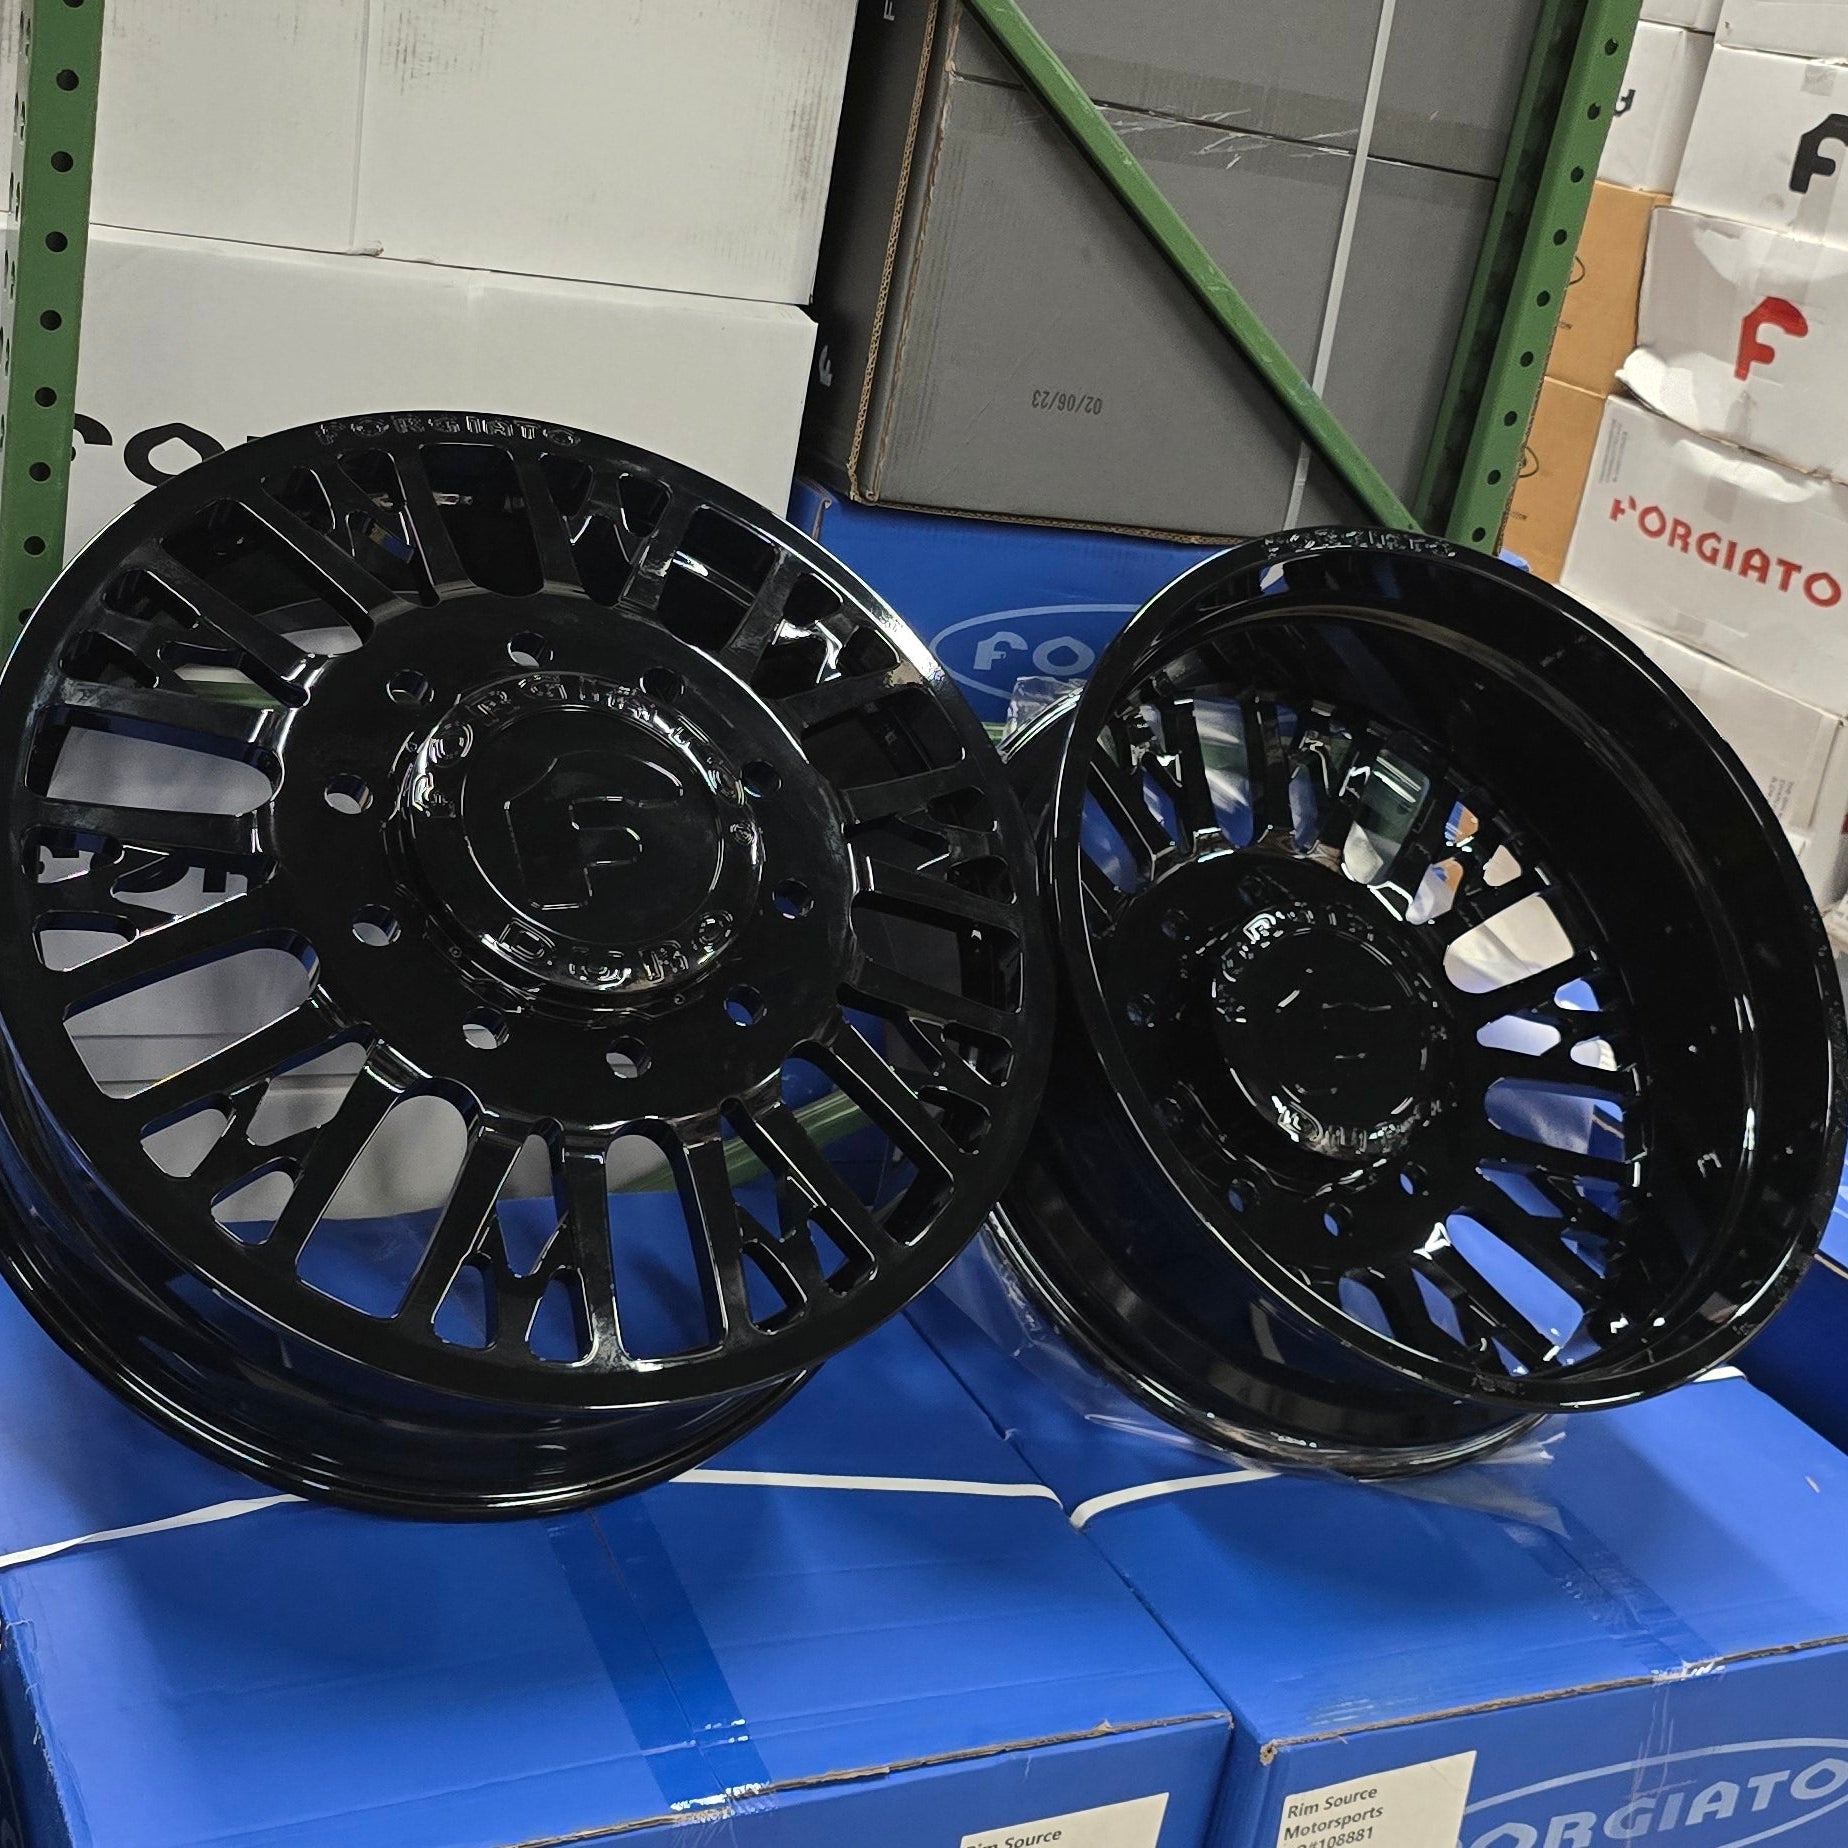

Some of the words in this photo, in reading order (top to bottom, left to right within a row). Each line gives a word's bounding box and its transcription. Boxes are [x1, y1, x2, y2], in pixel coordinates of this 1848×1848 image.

[1733, 295, 1809, 382] F
[1031, 389, 1103, 416] 02/06/23
[314, 413, 582, 447] FORGIATO
[972, 630, 1108, 677] FO
[1287, 1803, 1319, 1820] Rim
[1323, 1787, 1379, 1812] Source
[1457, 1757, 1848, 1848] ORGIATO
[1283, 1805, 1384, 1841] Motorsports
[1294, 1825, 1374, 1848] #108881
